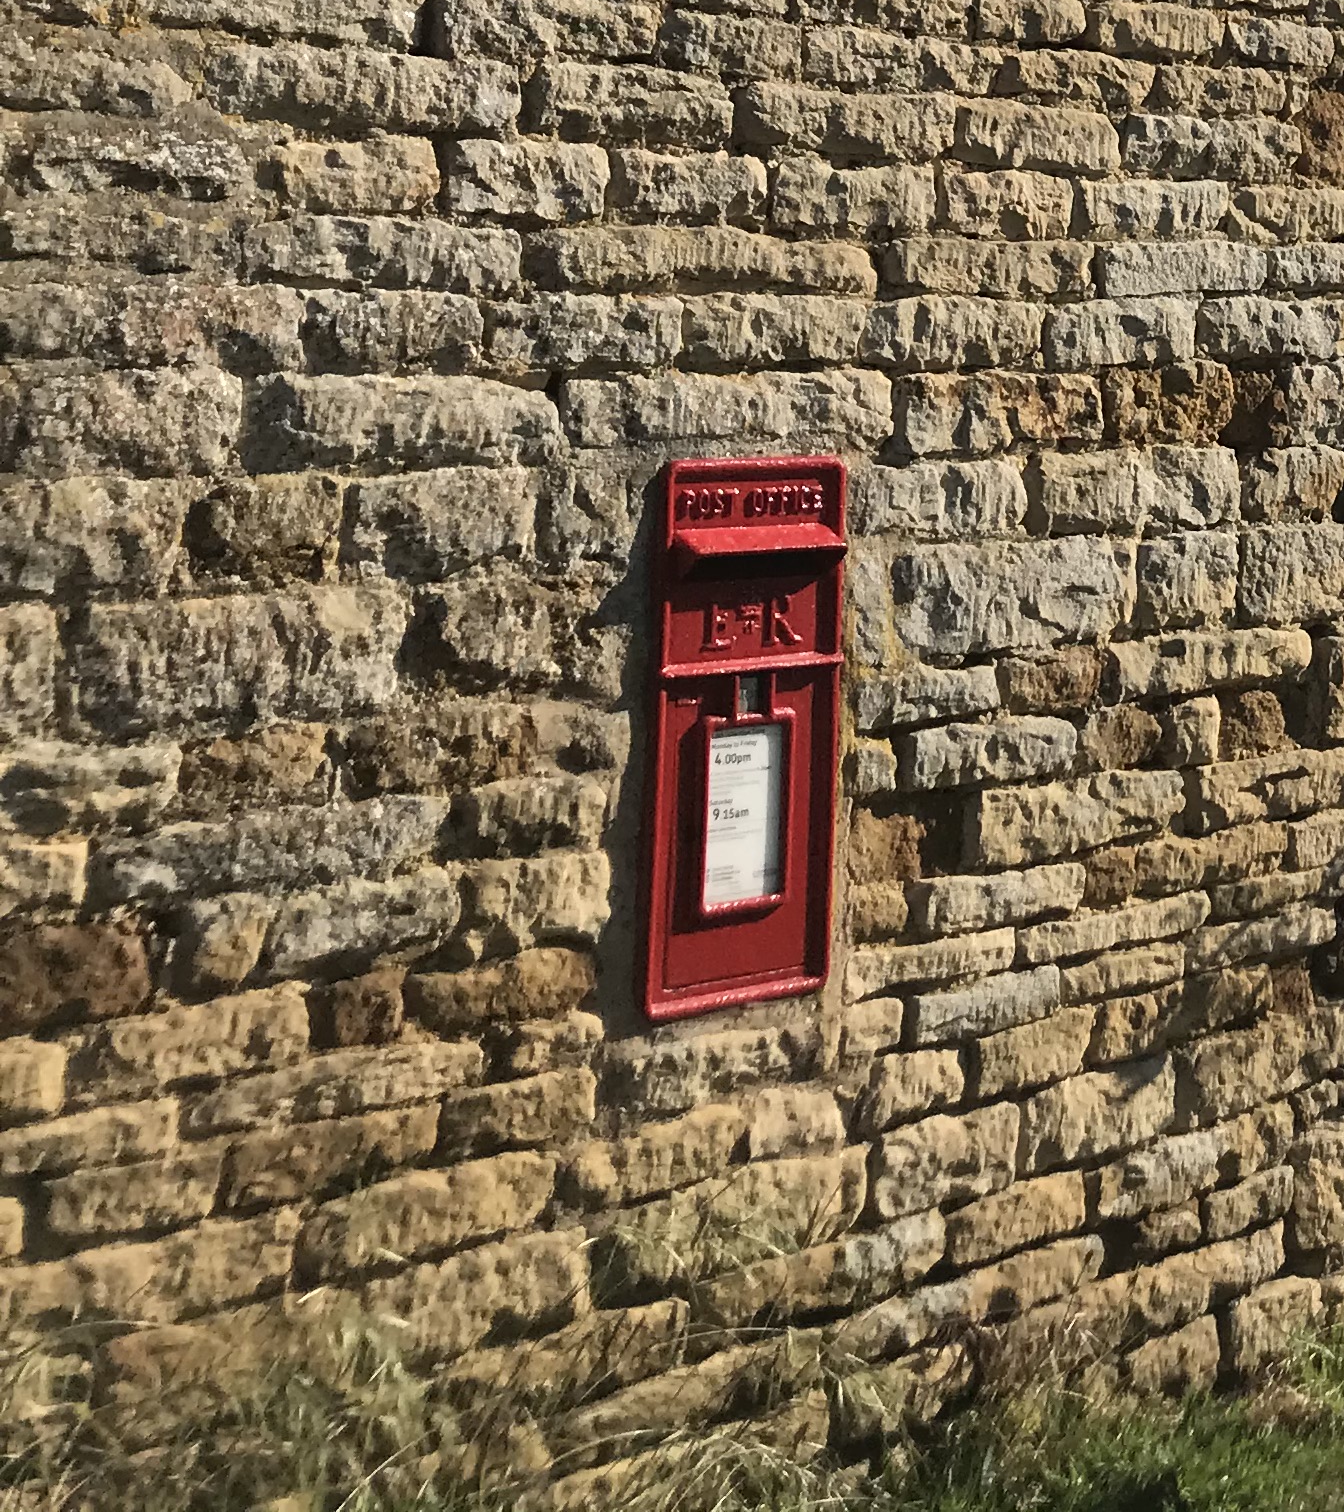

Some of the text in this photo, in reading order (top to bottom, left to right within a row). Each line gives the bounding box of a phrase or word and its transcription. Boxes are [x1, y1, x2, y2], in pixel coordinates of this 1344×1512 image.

[684, 485, 823, 515] POST OFFICE
[712, 808, 750, 821] 915am
